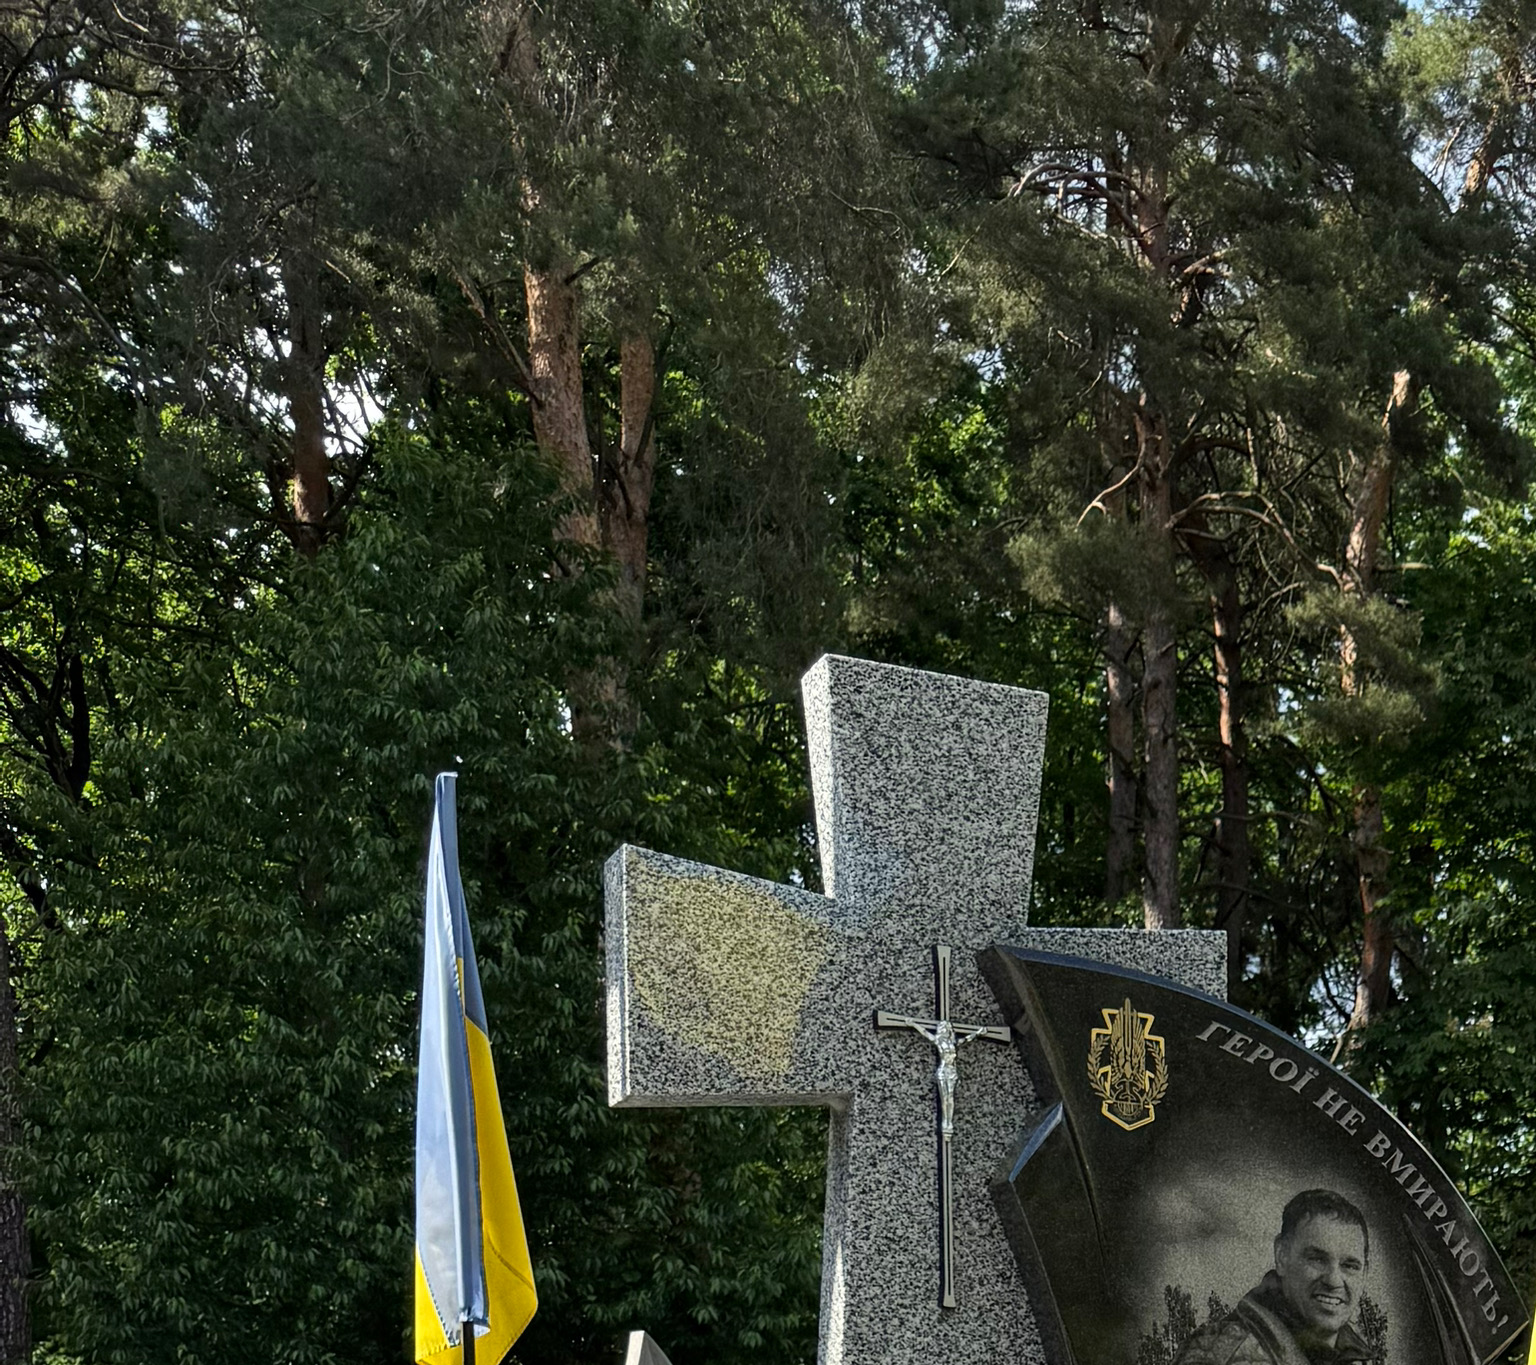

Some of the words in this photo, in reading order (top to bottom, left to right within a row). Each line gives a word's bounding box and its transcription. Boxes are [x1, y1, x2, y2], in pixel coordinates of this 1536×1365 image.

[1196, 1020, 1320, 1094] ГЕРОЇ
[1313, 1086, 1366, 1136] НЕ
[1363, 1129, 1509, 1335] ВМИРАЮТЬ!
